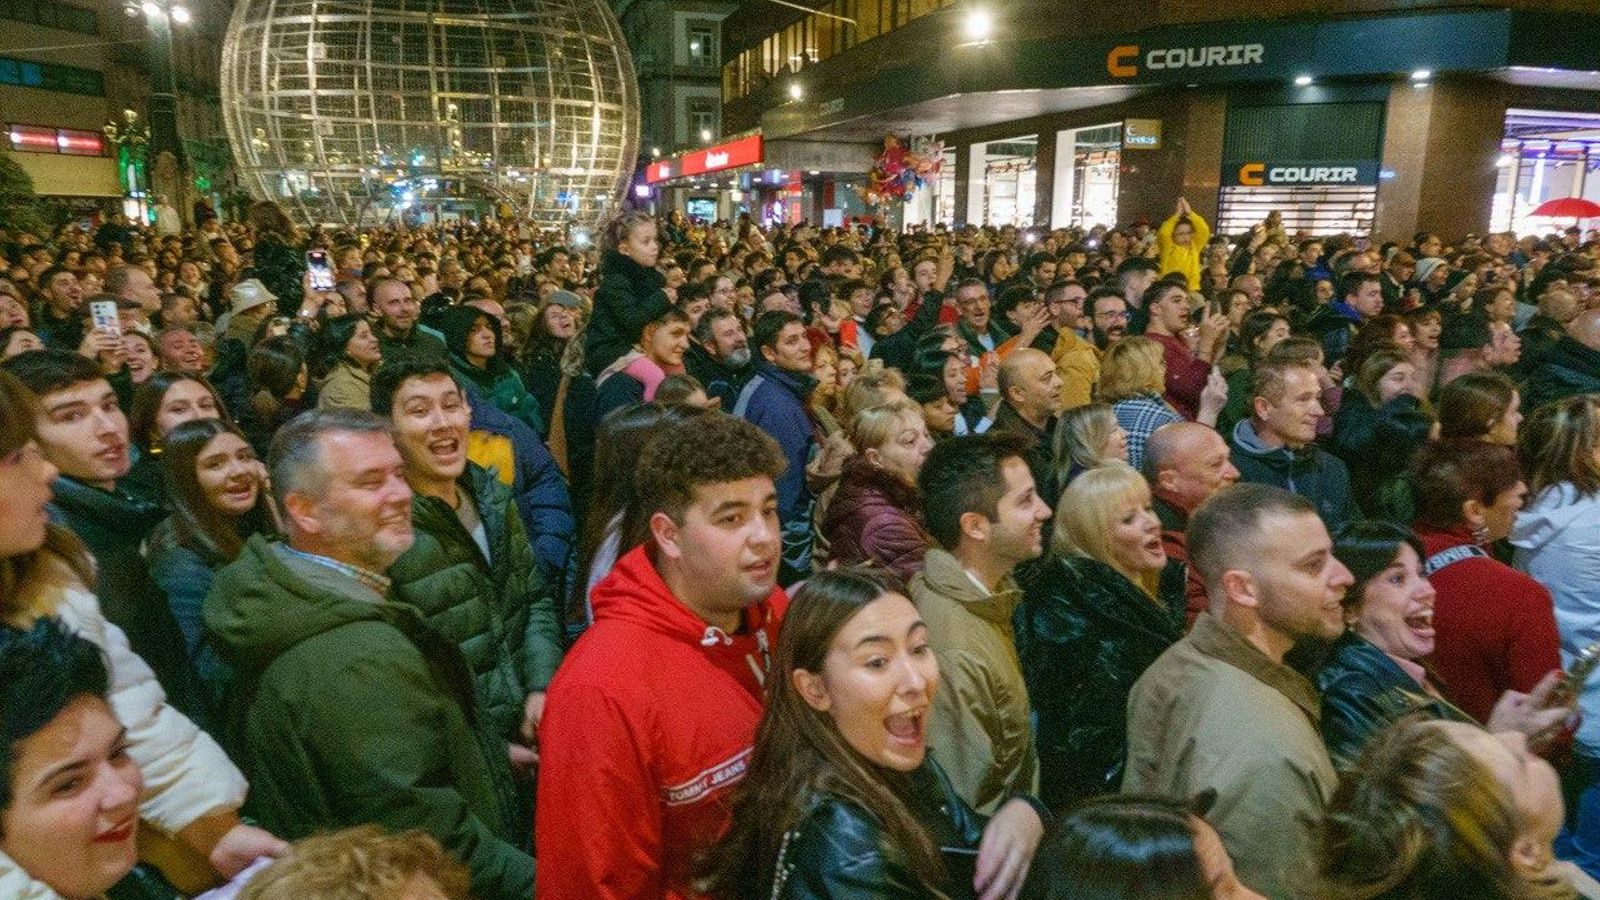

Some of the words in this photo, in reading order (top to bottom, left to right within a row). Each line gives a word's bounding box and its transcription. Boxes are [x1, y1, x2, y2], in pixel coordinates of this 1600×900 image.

[1146, 43, 1265, 70] COURIR
[1269, 166, 1358, 183] COURIR
[711, 759, 746, 785] JEANS
